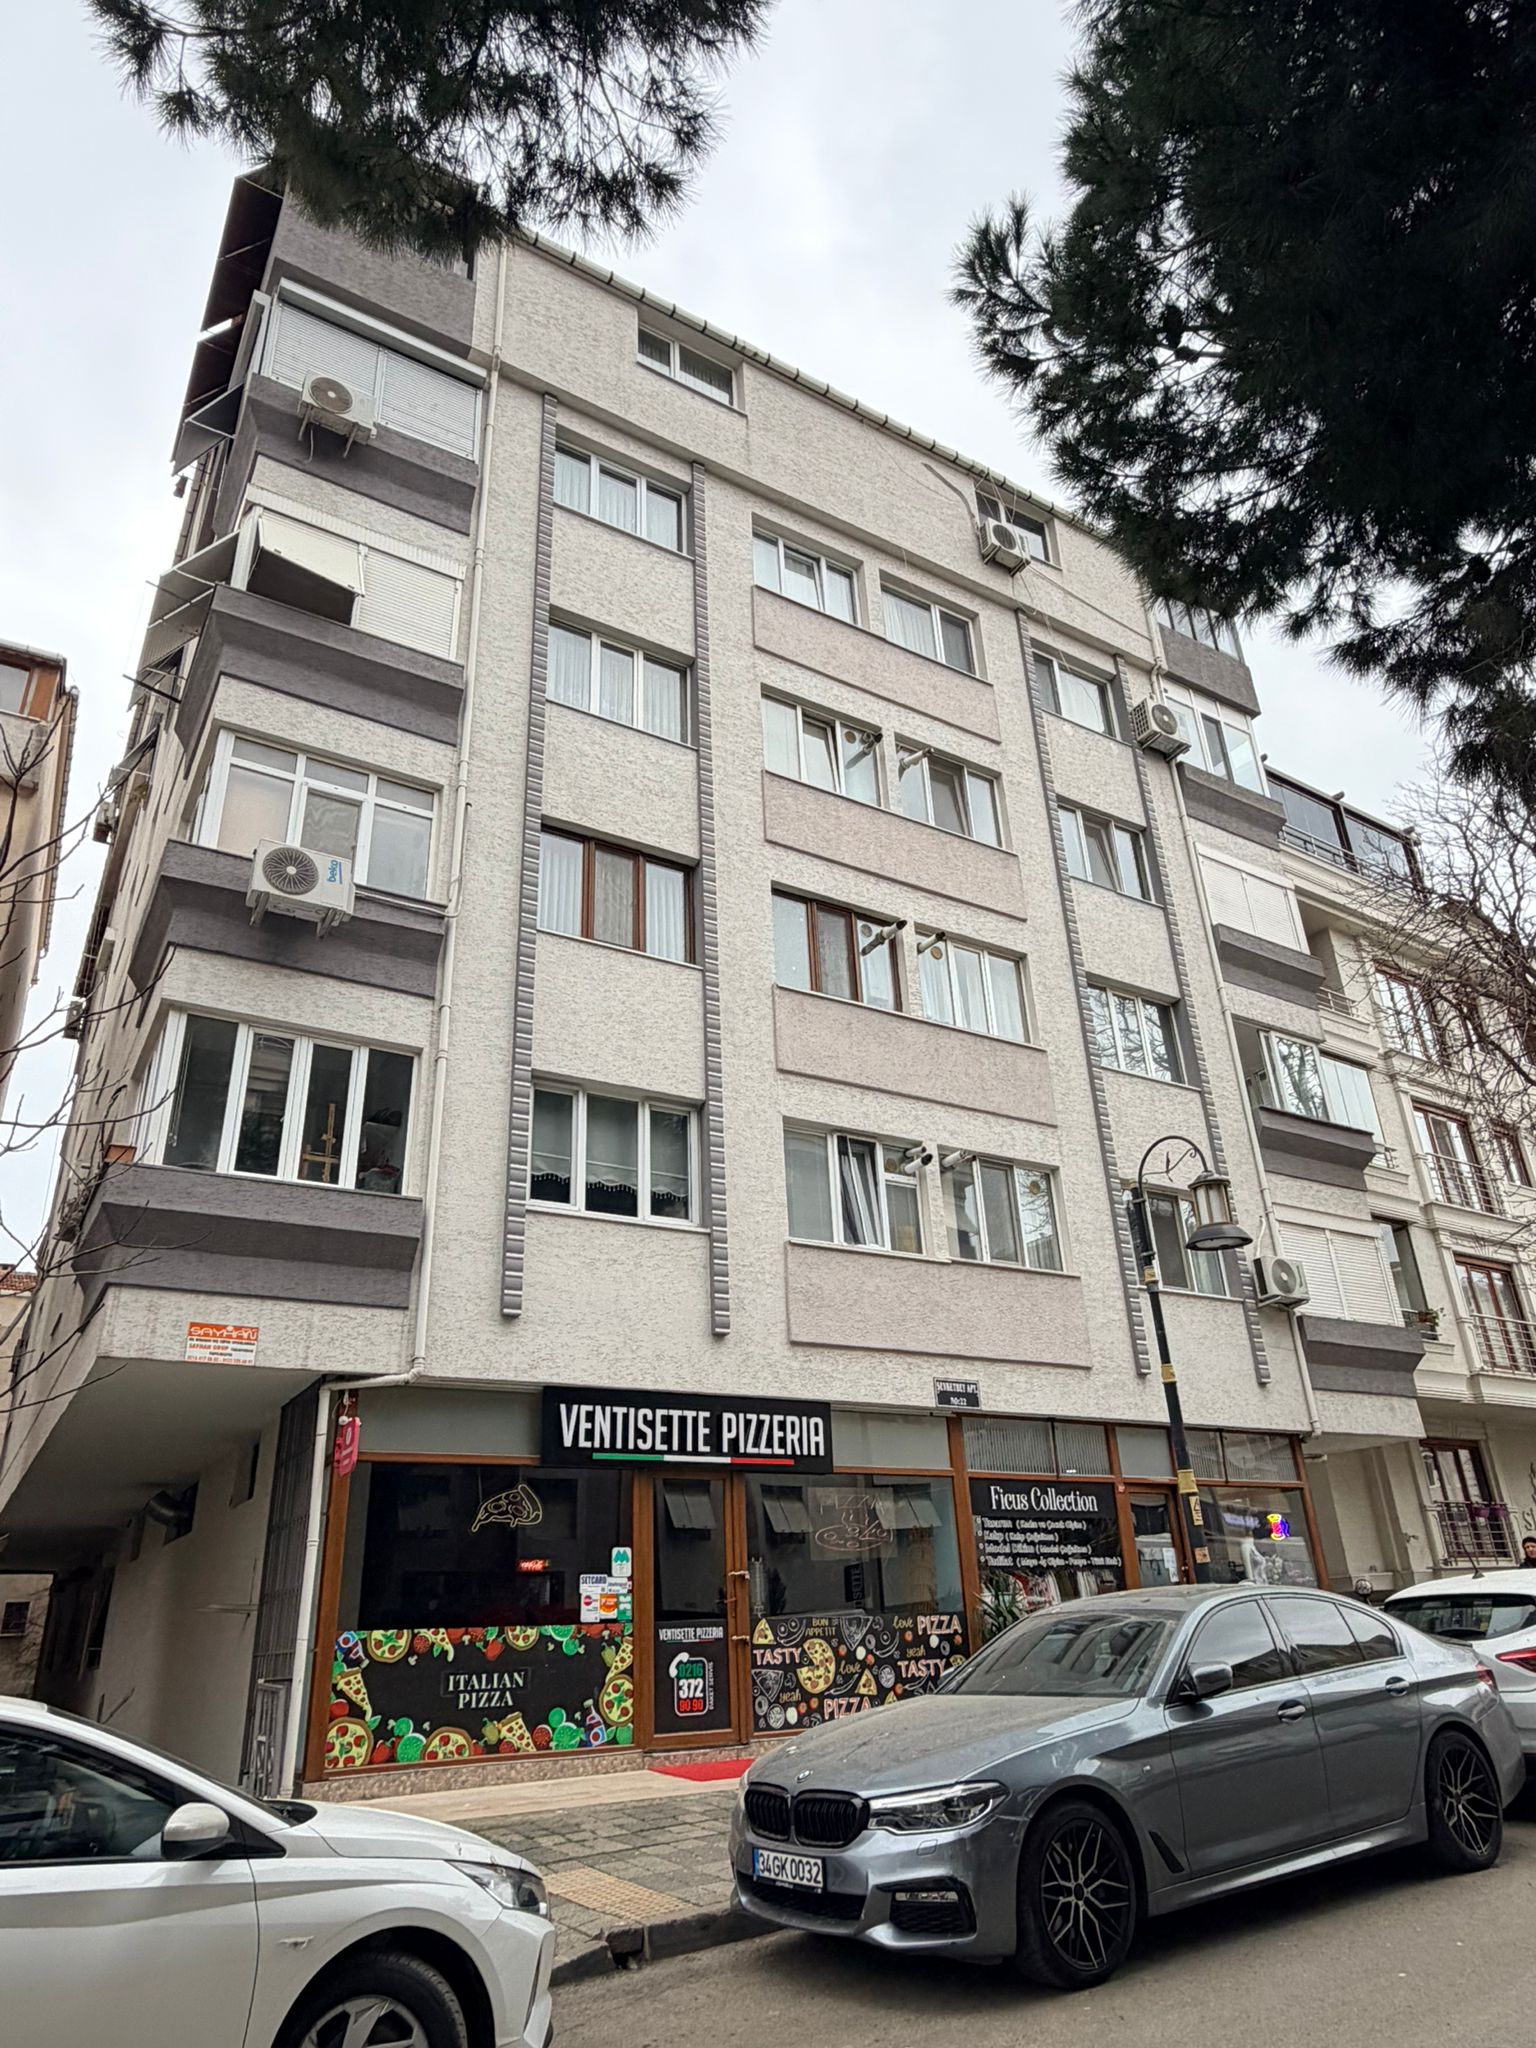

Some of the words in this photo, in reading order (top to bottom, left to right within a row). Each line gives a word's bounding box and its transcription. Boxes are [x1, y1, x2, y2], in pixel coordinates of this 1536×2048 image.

[327, 859, 338, 882] beko
[559, 1403, 711, 1452] VENTISETTE
[721, 1411, 826, 1457] PIZZERIA
[990, 1485, 1029, 1511] Ficus
[1030, 1486, 1099, 1512] Collection
[812, 1618, 829, 1626] BON
[892, 1616, 914, 1630] love
[917, 1615, 962, 1635] PIZZA
[659, 1628, 695, 1641] VENTISETTE
[696, 1626, 723, 1639] PIZZERIA
[753, 1647, 802, 1666] TASTY
[839, 1660, 862, 1675] love
[897, 1658, 946, 1679] TASTY
[448, 1671, 525, 1691] ITALIAN
[679, 1678, 704, 1699] 372
[458, 1690, 514, 1709] PIZZA
[824, 1696, 871, 1720] PIZZA
